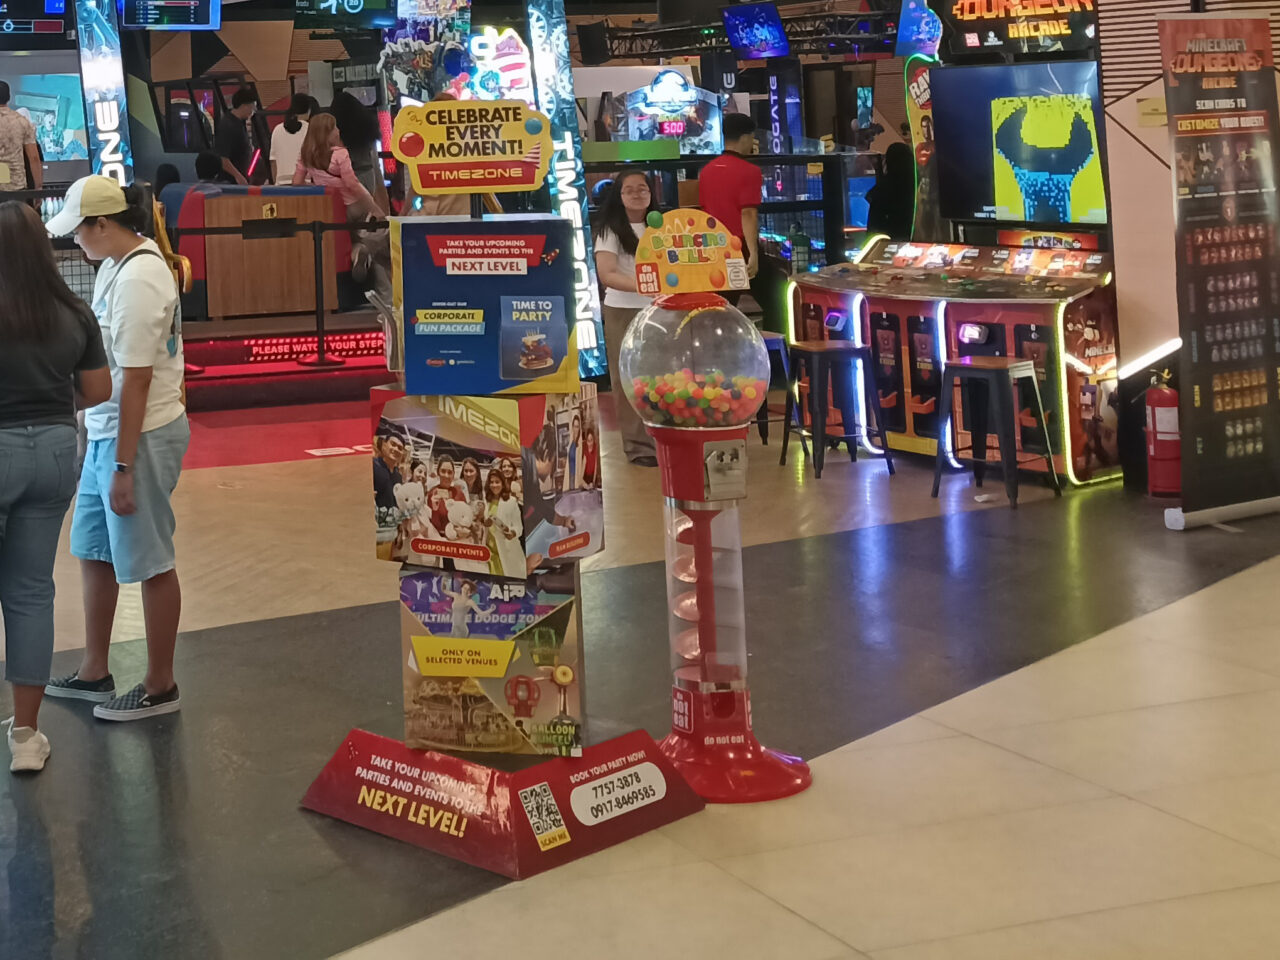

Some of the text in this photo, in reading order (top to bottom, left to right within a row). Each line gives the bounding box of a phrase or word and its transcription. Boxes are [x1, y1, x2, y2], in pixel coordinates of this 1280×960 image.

[1008, 19, 1072, 38] ARCADE
[1186, 39, 1247, 52] MINECRAFT
[1171, 53, 1262, 73] DUNGEONS
[425, 107, 522, 125] CELEBRATE
[663, 121, 684, 134] 500
[1178, 119, 1219, 130] CUSTOMIZE
[446, 124, 503, 141] EVERY
[428, 139, 523, 158] MOMENT!
[428, 167, 523, 181] TIMEZONE
[451, 261, 522, 272] NEXT LEVEL
[641, 265, 652, 273] do
[639, 272, 656, 283] not
[640, 281, 659, 293] eat
[512, 301, 552, 310] TIME TO
[424, 312, 475, 320] CORPORATE
[512, 311, 552, 321] PARTY
[420, 324, 481, 333] FUN PACKAGE
[253, 340, 383, 354] PLEASE WATC YOUR STEP
[418, 542, 484, 558] CORPORATE EVENTS
[417, 612, 472, 623] ULTIME
[475, 613, 515, 624] DODGE
[441, 649, 465, 657] ONLY
[425, 656, 498, 666] SELECTED VENUES
[673, 700, 689, 716] not
[673, 713, 689, 729] eat
[704, 734, 744, 745] do not eat
[370, 754, 477, 796] TAKE YOUR UPCOMING
[569, 771, 590, 784] BOOK
[589, 764, 609, 779] YOUR
[608, 756, 627, 770] PARTY
[355, 766, 483, 815] PARTIES AND EVENTS TO THE
[591, 771, 642, 800] 7757-3878
[590, 785, 656, 819] 0917-8469585
[357, 785, 468, 838] NEXT LEVEL!
[540, 832, 568, 849] SCAN ME
